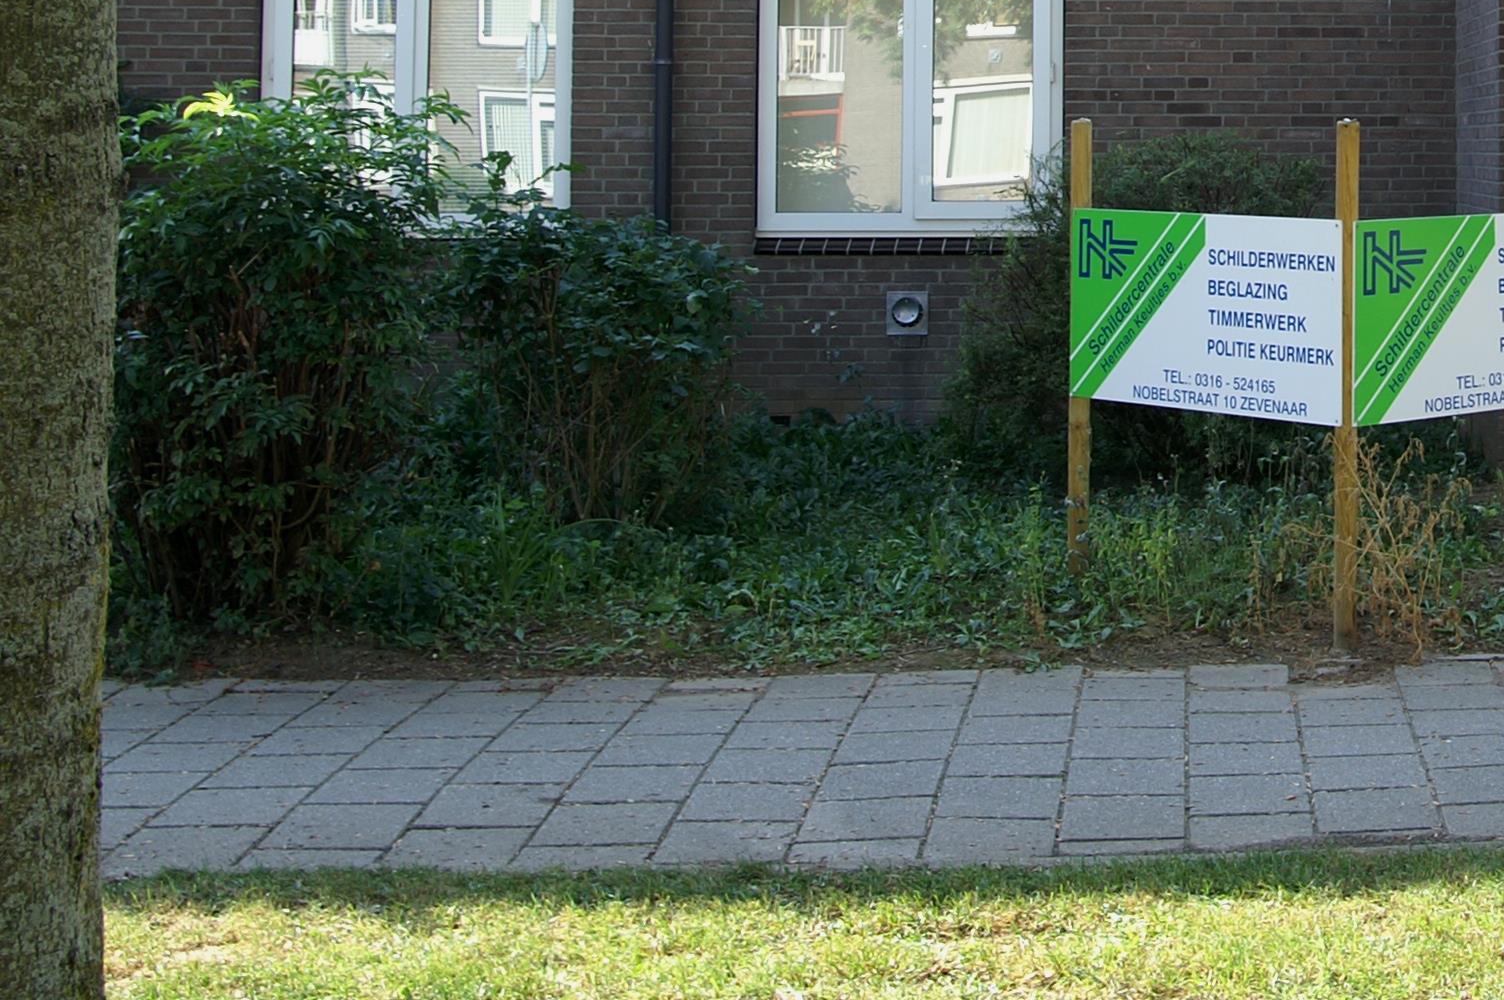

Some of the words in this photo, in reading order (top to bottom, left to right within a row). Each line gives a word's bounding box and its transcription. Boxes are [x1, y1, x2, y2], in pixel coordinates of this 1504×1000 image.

[1208, 249, 1336, 272] SCHILDERWERKEN
[1088, 240, 1175, 356] Schildercentrale
[1208, 280, 1288, 301] BEGLAZING
[1208, 309, 1307, 333] TIMMERWERK
[1375, 245, 1465, 378] Schildercentrale
[1100, 327, 1135, 373] Herman
[1135, 282, 1170, 329] Keultjes
[1388, 340, 1426, 393] Herman
[1424, 288, 1460, 340] Keultjes
[1207, 339, 1256, 359] POLITIE
[1260, 344, 1334, 366] KEURMERK
[1195, 373, 1222, 389] 0316
[1233, 378, 1276, 394] 524165
[1133, 385, 1220, 406] NOBELSTRAAT
[1224, 396, 1237, 409] 10
[1240, 397, 1308, 417] ZEVENAAR
